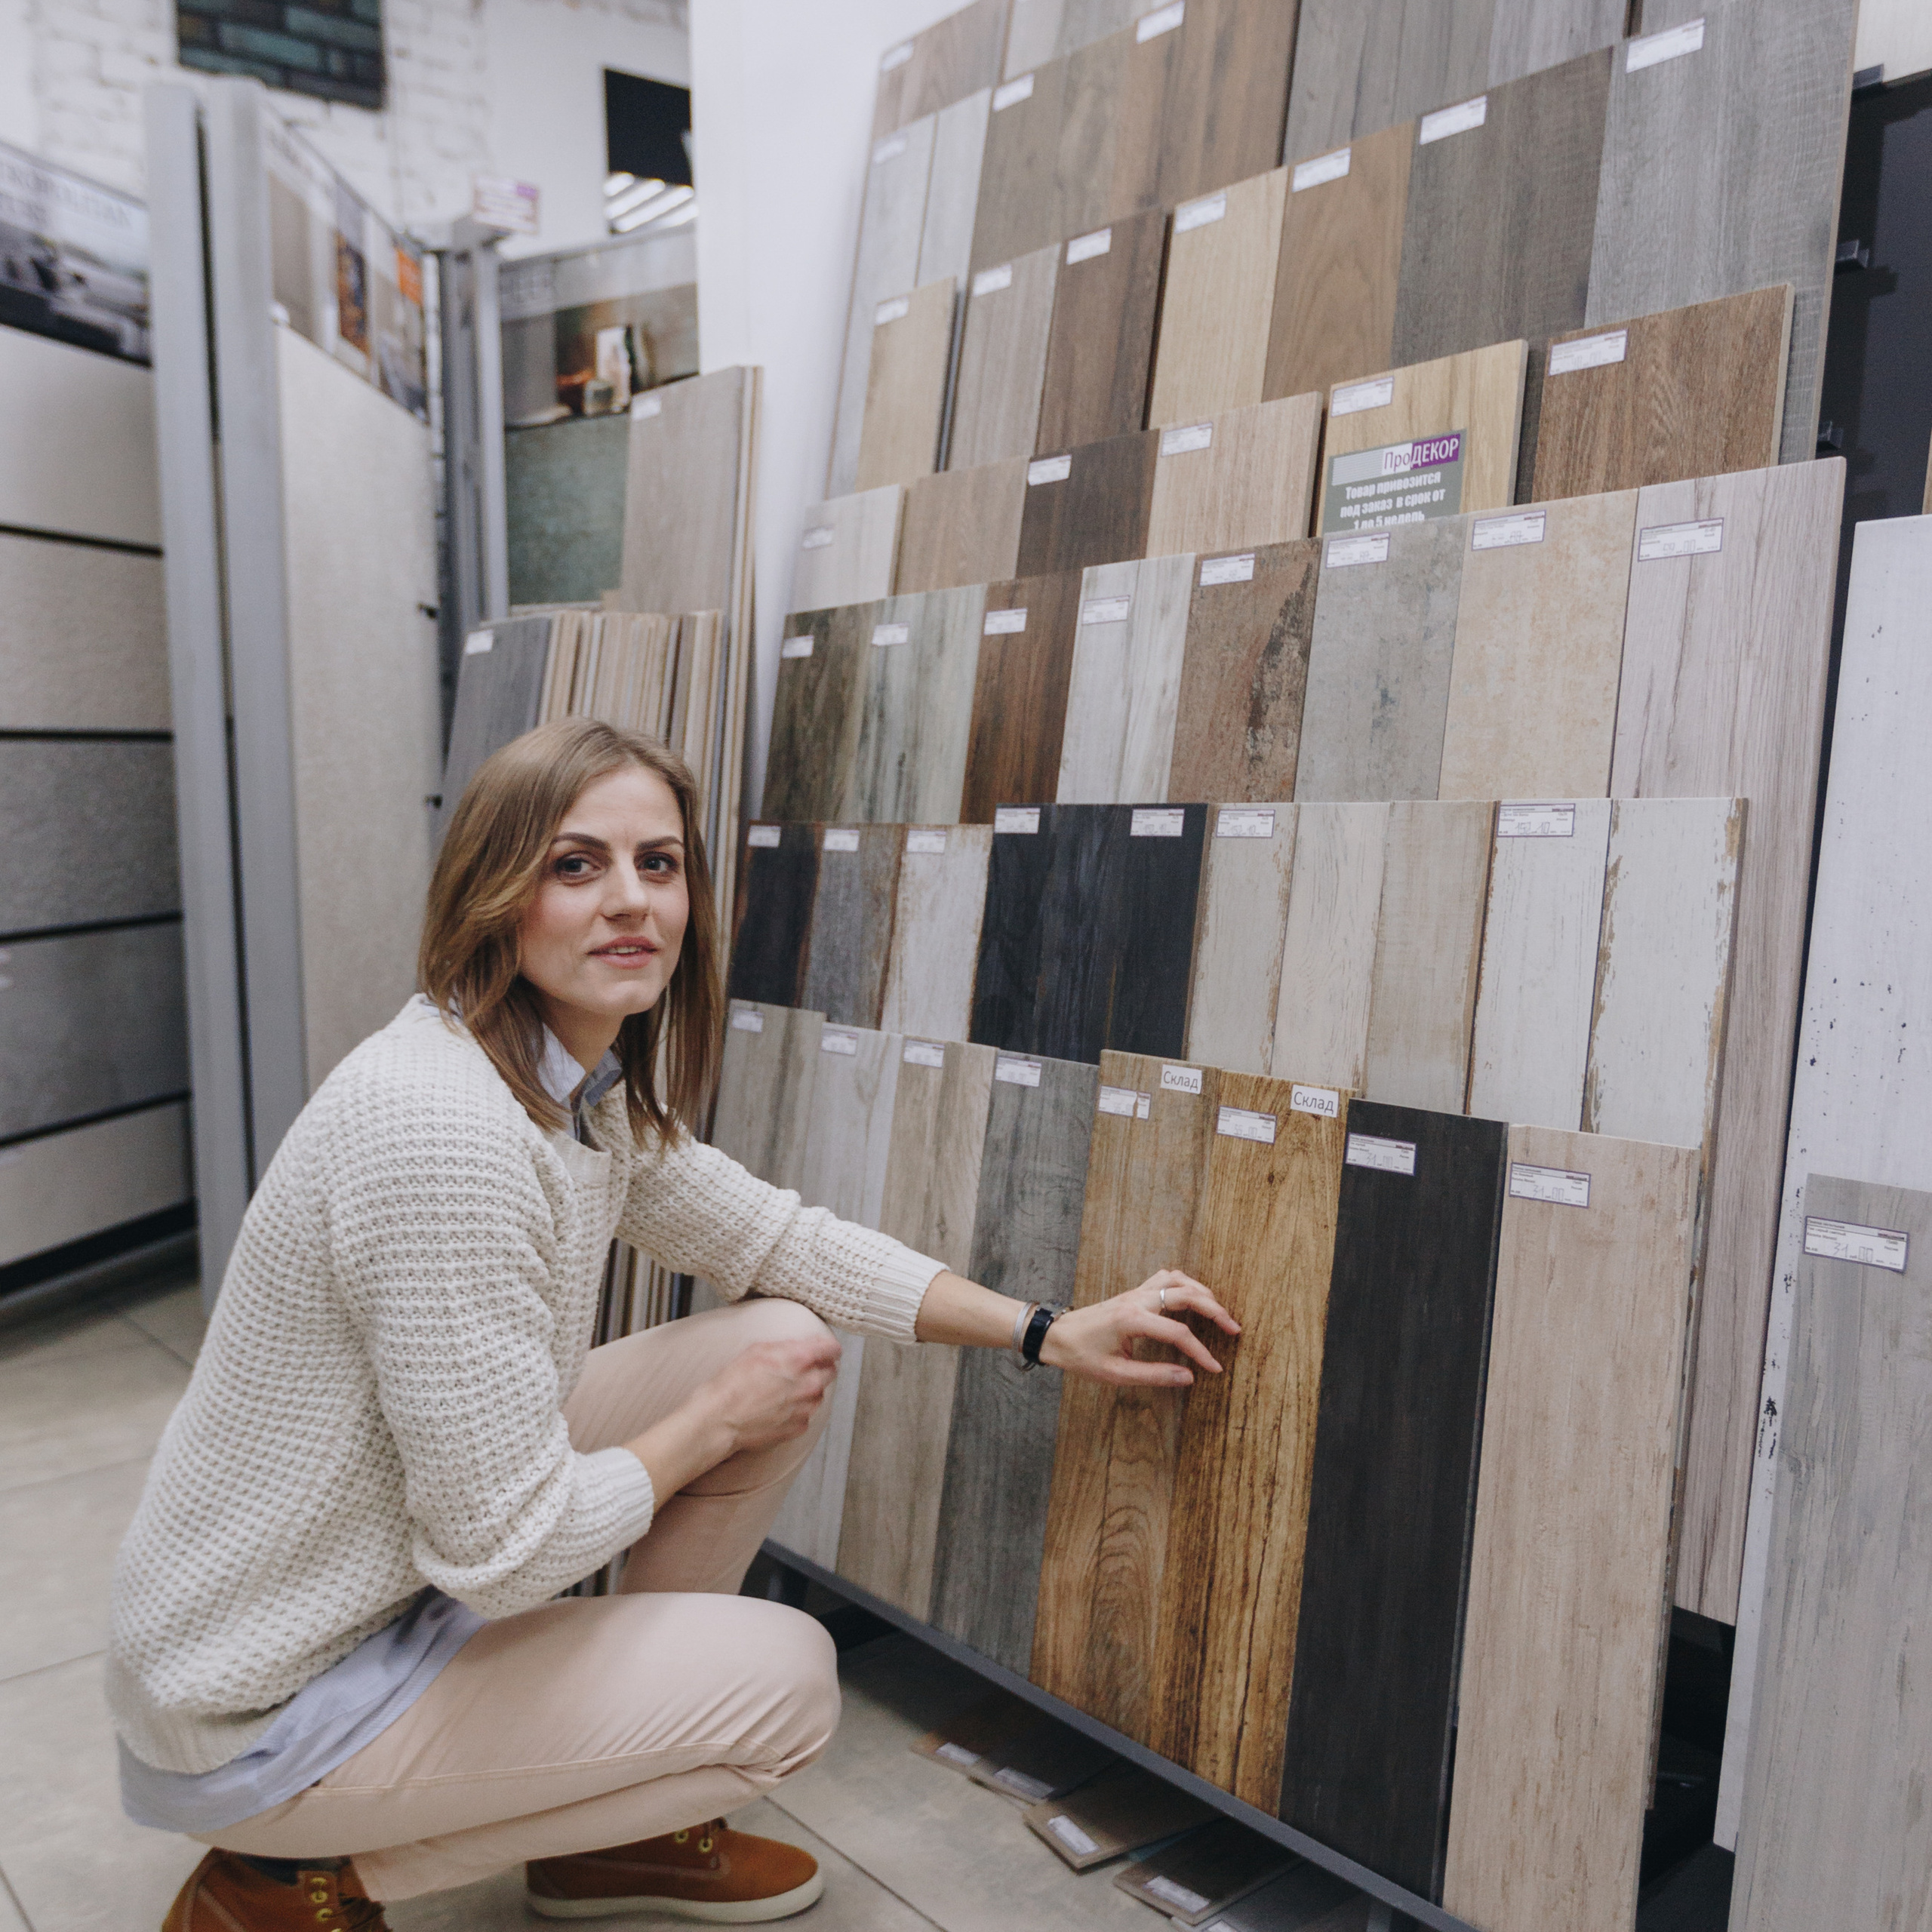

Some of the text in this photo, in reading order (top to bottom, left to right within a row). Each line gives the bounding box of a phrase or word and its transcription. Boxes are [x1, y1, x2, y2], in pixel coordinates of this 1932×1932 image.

[1384, 438, 1459, 472] ПроДЕКОР
[1346, 472, 1441, 500] Товар привозится
[1340, 489, 1446, 518] под заказ в срок от
[1354, 520, 1359, 529] 1
[1376, 515, 1383, 527] 5
[1164, 1071, 1198, 1091] Склад
[1294, 1091, 1334, 1115] Склад
[1832, 1241, 1848, 1258] 31
